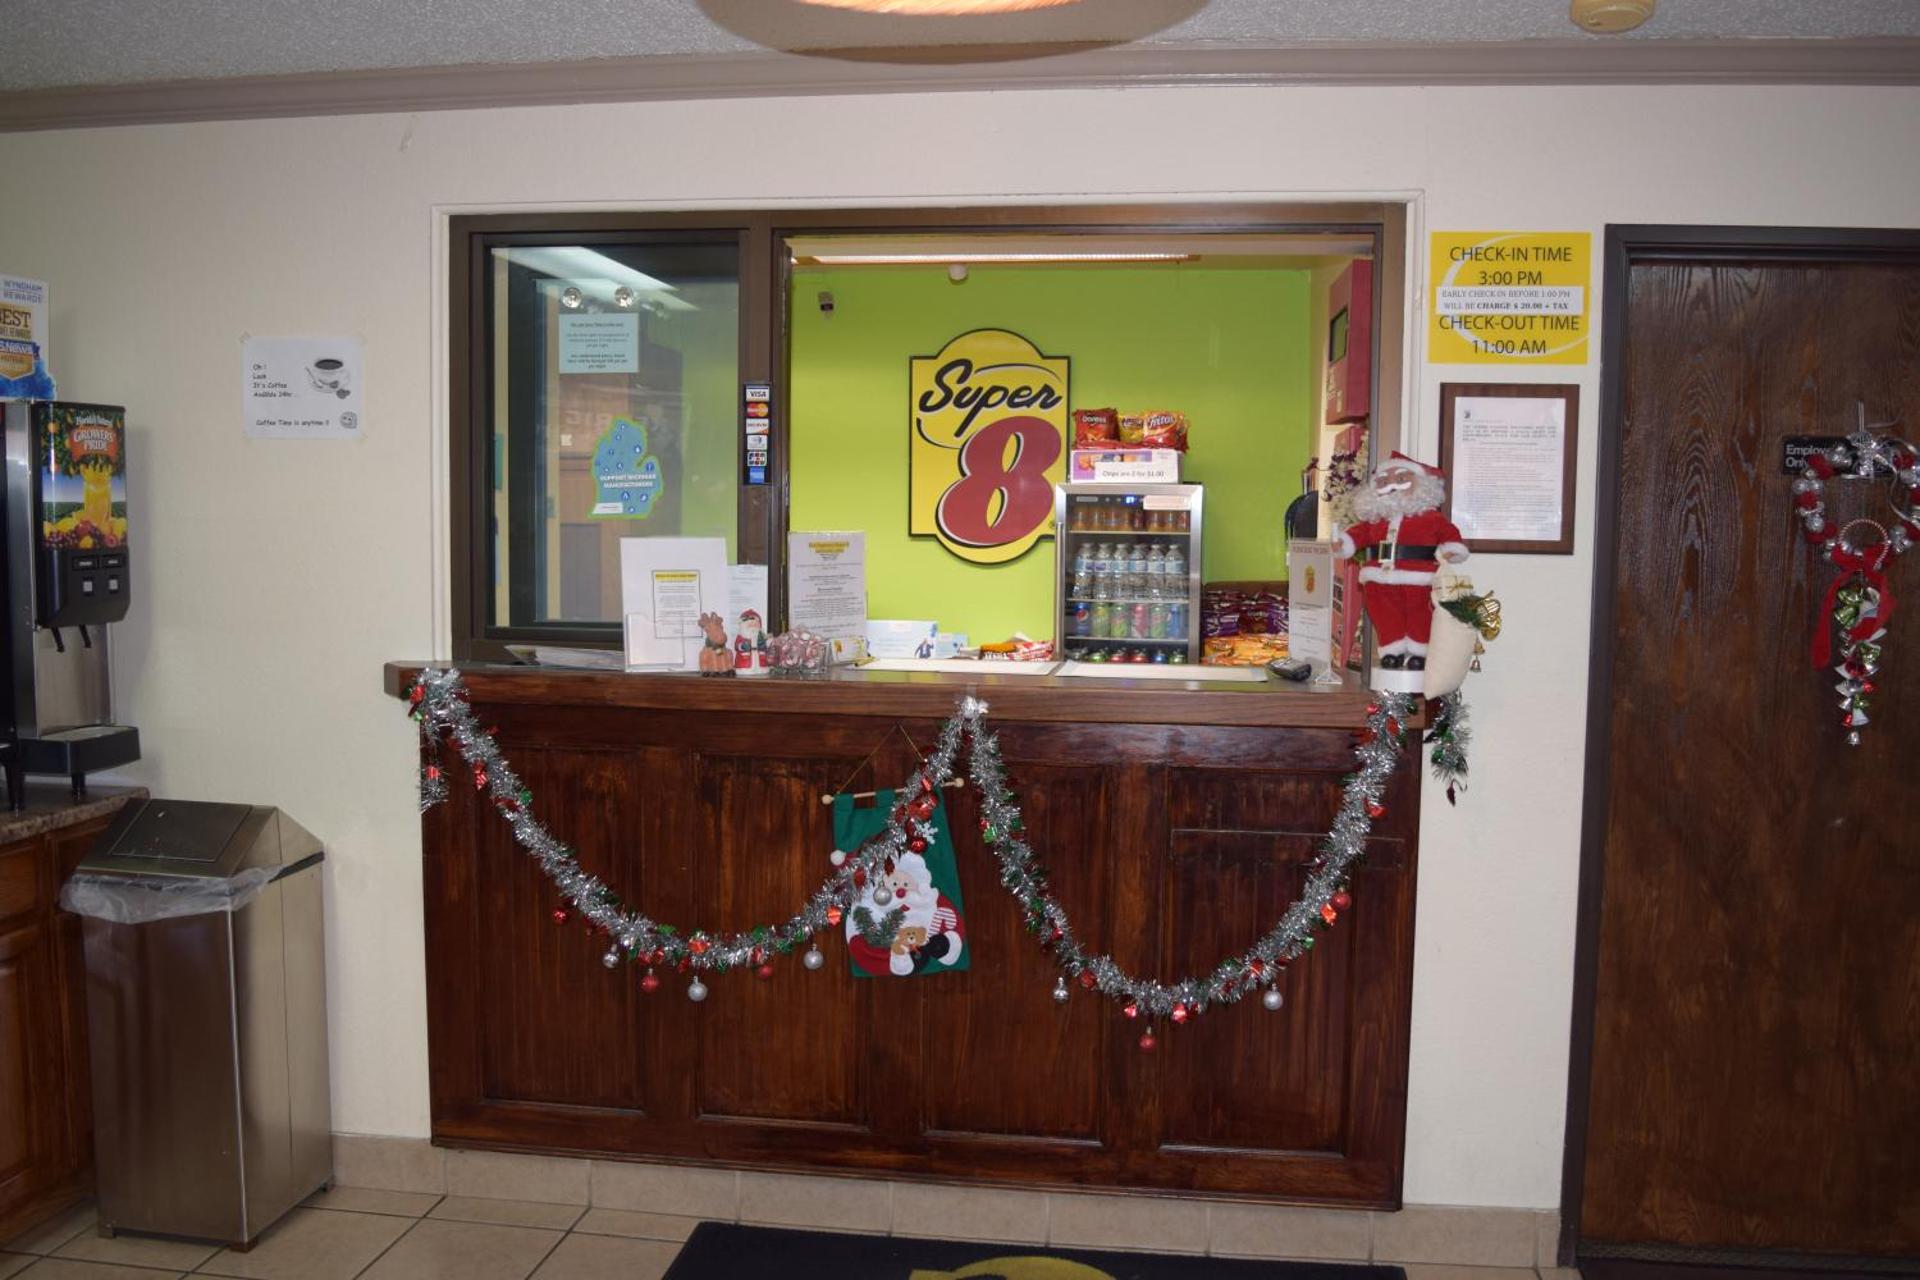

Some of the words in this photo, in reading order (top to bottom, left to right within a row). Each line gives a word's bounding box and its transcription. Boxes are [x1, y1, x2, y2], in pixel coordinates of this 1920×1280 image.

[1449, 246, 1528, 262] CHECK-IN
[1533, 246, 1573, 262] TIME
[3, 280, 42, 291] WYNDHAM
[1479, 271, 1513, 286] 3:00
[1517, 271, 1543, 286] PM
[3, 290, 42, 304] REWARDS
[1442, 289, 1466, 298] EARLY
[1508, 289, 1538, 298] BEFORE
[1557, 289, 1570, 298] PM
[1443, 302, 1463, 310] WILL
[1465, 302, 1475, 310] BE
[1476, 302, 1511, 310] CHARGE
[1520, 302, 1543, 310] 20.00
[1553, 302, 1568, 310] TAX
[1438, 314, 1536, 331] CHECK-OUT
[1540, 314, 1580, 331] TIME
[1472, 339, 1515, 354] 11:00
[1519, 339, 1547, 354] AM
[918, 358, 1063, 438] Super
[301, 419, 323, 428] anytime
[83, 439, 109, 451] PRIDE
[1102, 470, 1119, 478] Chips
[1147, 470, 1165, 478] $1.00
[935, 415, 1062, 548] 8
